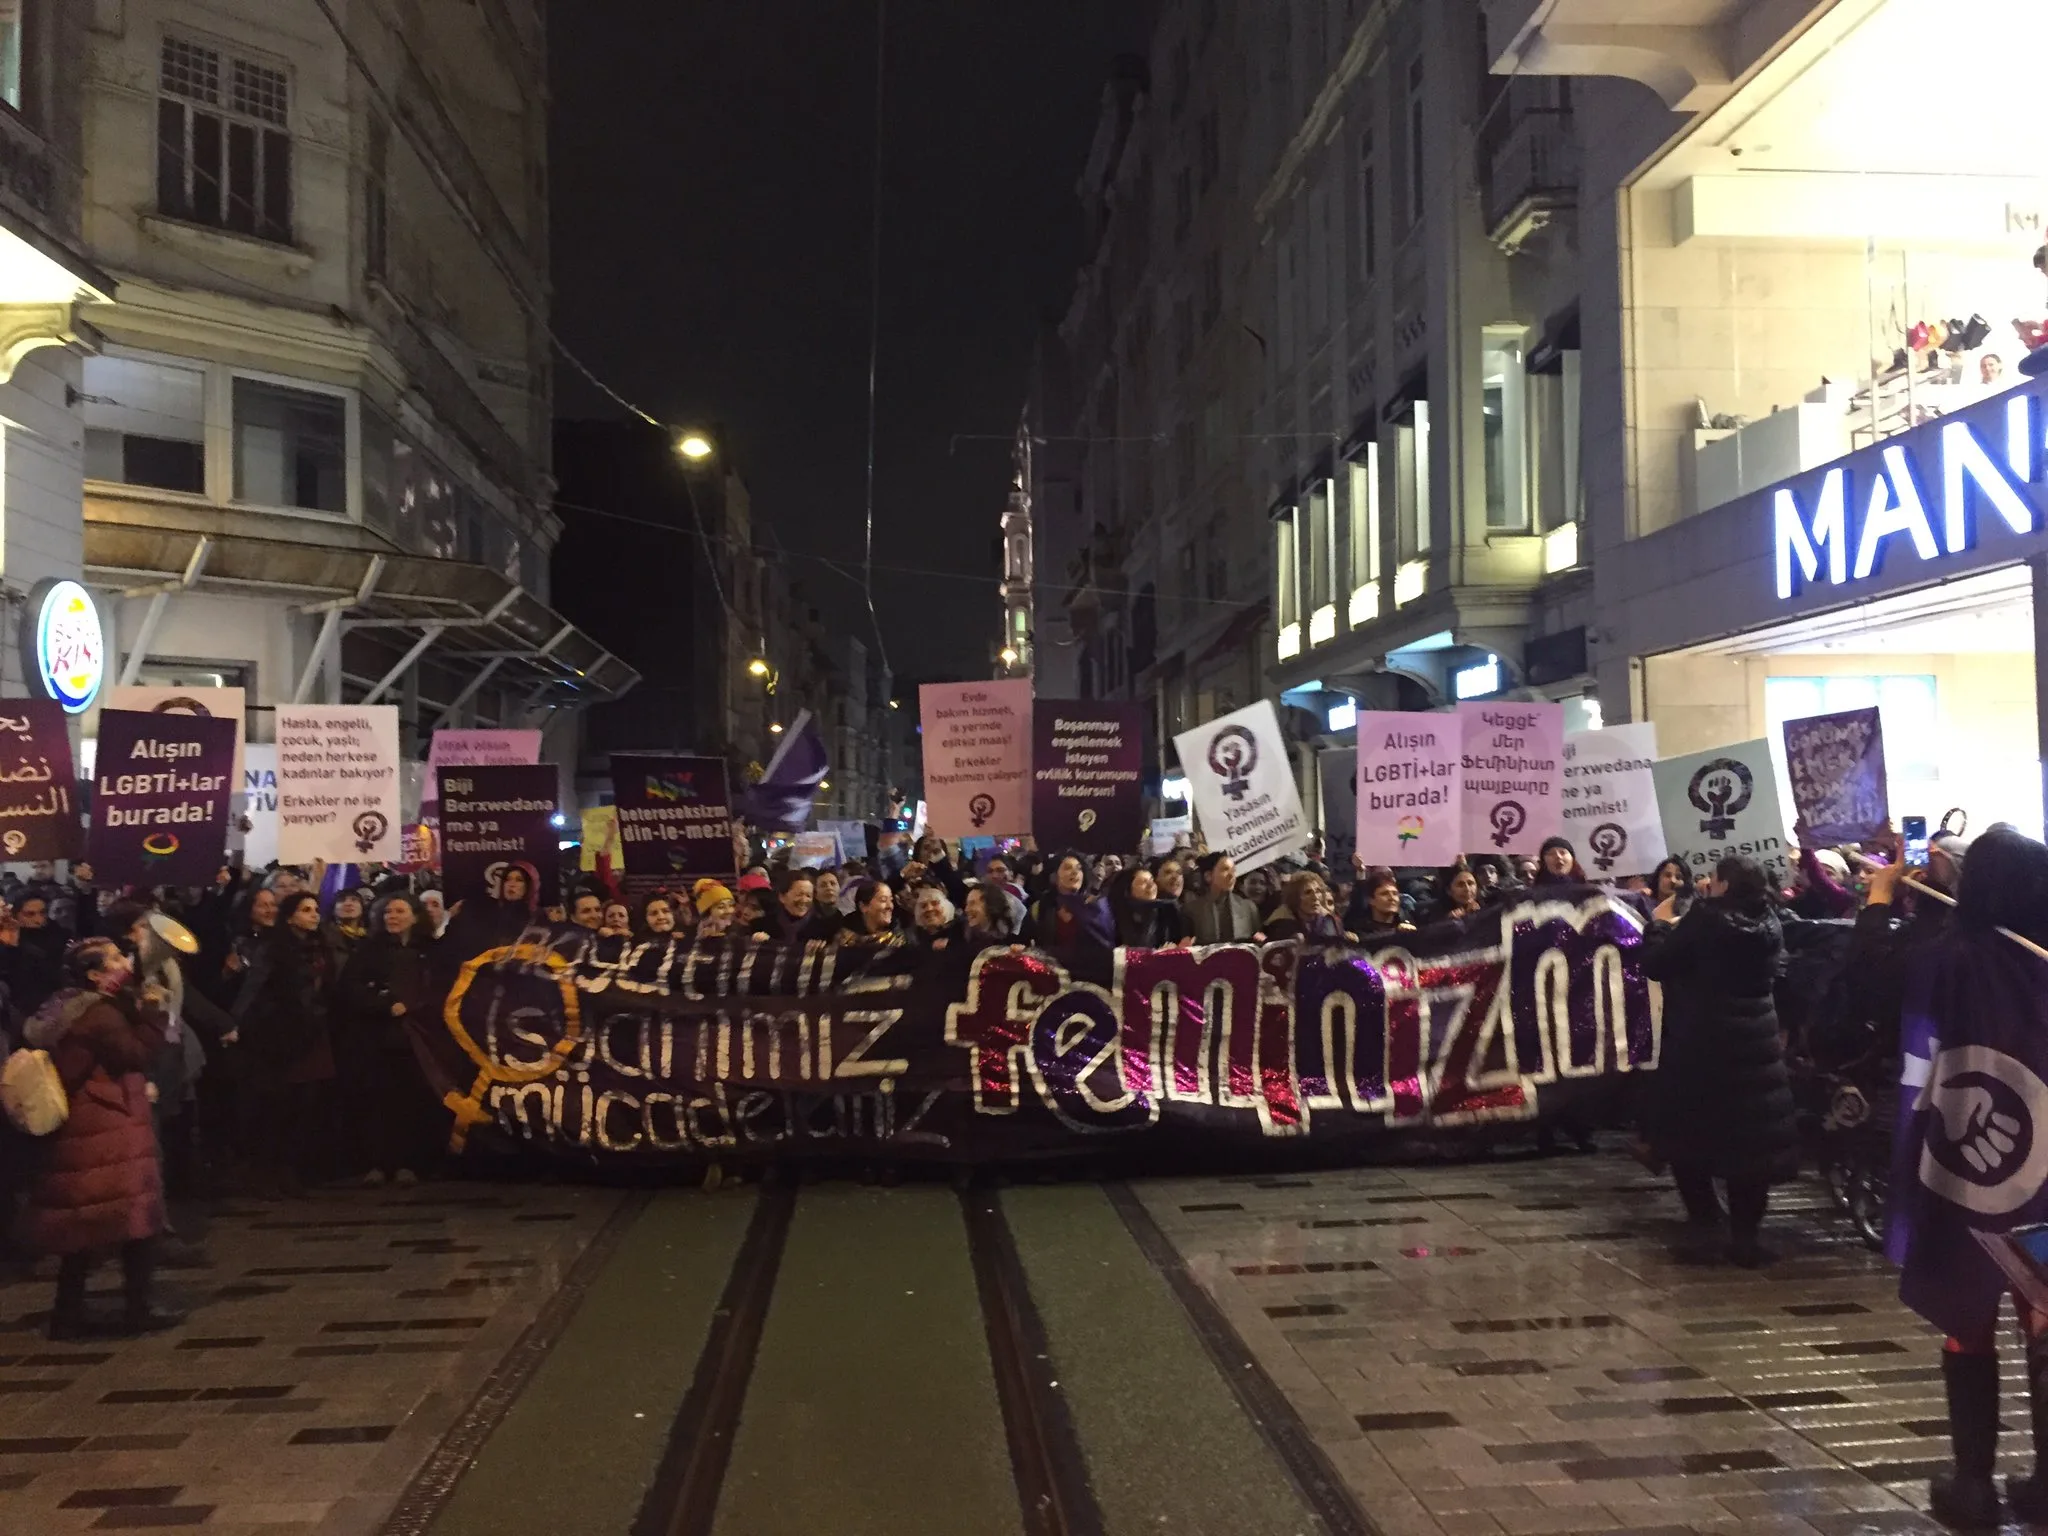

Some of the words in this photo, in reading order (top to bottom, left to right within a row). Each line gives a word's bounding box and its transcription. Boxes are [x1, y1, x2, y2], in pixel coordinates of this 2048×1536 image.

[1774, 394, 2048, 600] MAN
[281, 718, 322, 730] Hasta,
[325, 718, 372, 731] engelli,
[1054, 718, 1120, 735] Boşanmayı
[281, 735, 323, 748] çocuk,
[1051, 735, 1123, 750] engellemek
[1384, 732, 1436, 753] Alışın
[129, 738, 202, 763] Alışın
[282, 752, 322, 763] neden
[325, 752, 377, 763] herkese
[954, 757, 1002, 769] Erkekler
[1065, 752, 1109, 767] isteyen
[1563, 758, 1653, 778] erxwedana
[282, 768, 336, 780] kadınlar
[340, 766, 394, 783] bakıyor?
[1036, 767, 1073, 780] evlilik
[1075, 768, 1138, 781] kurumunu
[1364, 758, 1456, 784] LGBTİ+lar
[100, 768, 226, 796] LGBTİ+lar
[1058, 784, 1116, 798] kaldırsın!
[1370, 785, 1449, 810] burada!
[1583, 784, 1602, 799] ya
[283, 795, 340, 808] Erkekler
[343, 796, 360, 806] ne
[444, 797, 554, 813] Berxwedana
[1562, 799, 1629, 819] eminist!
[106, 800, 214, 827] burada!
[283, 811, 337, 827] yarıyor?
[619, 804, 729, 822] heteroseksizm
[446, 821, 475, 832] me
[478, 820, 500, 835] ya
[623, 819, 731, 842] din-le-mez!
[1226, 806, 1281, 840] Feminist
[446, 836, 525, 852] feminist!
[945, 893, 1663, 1137] feminizm
